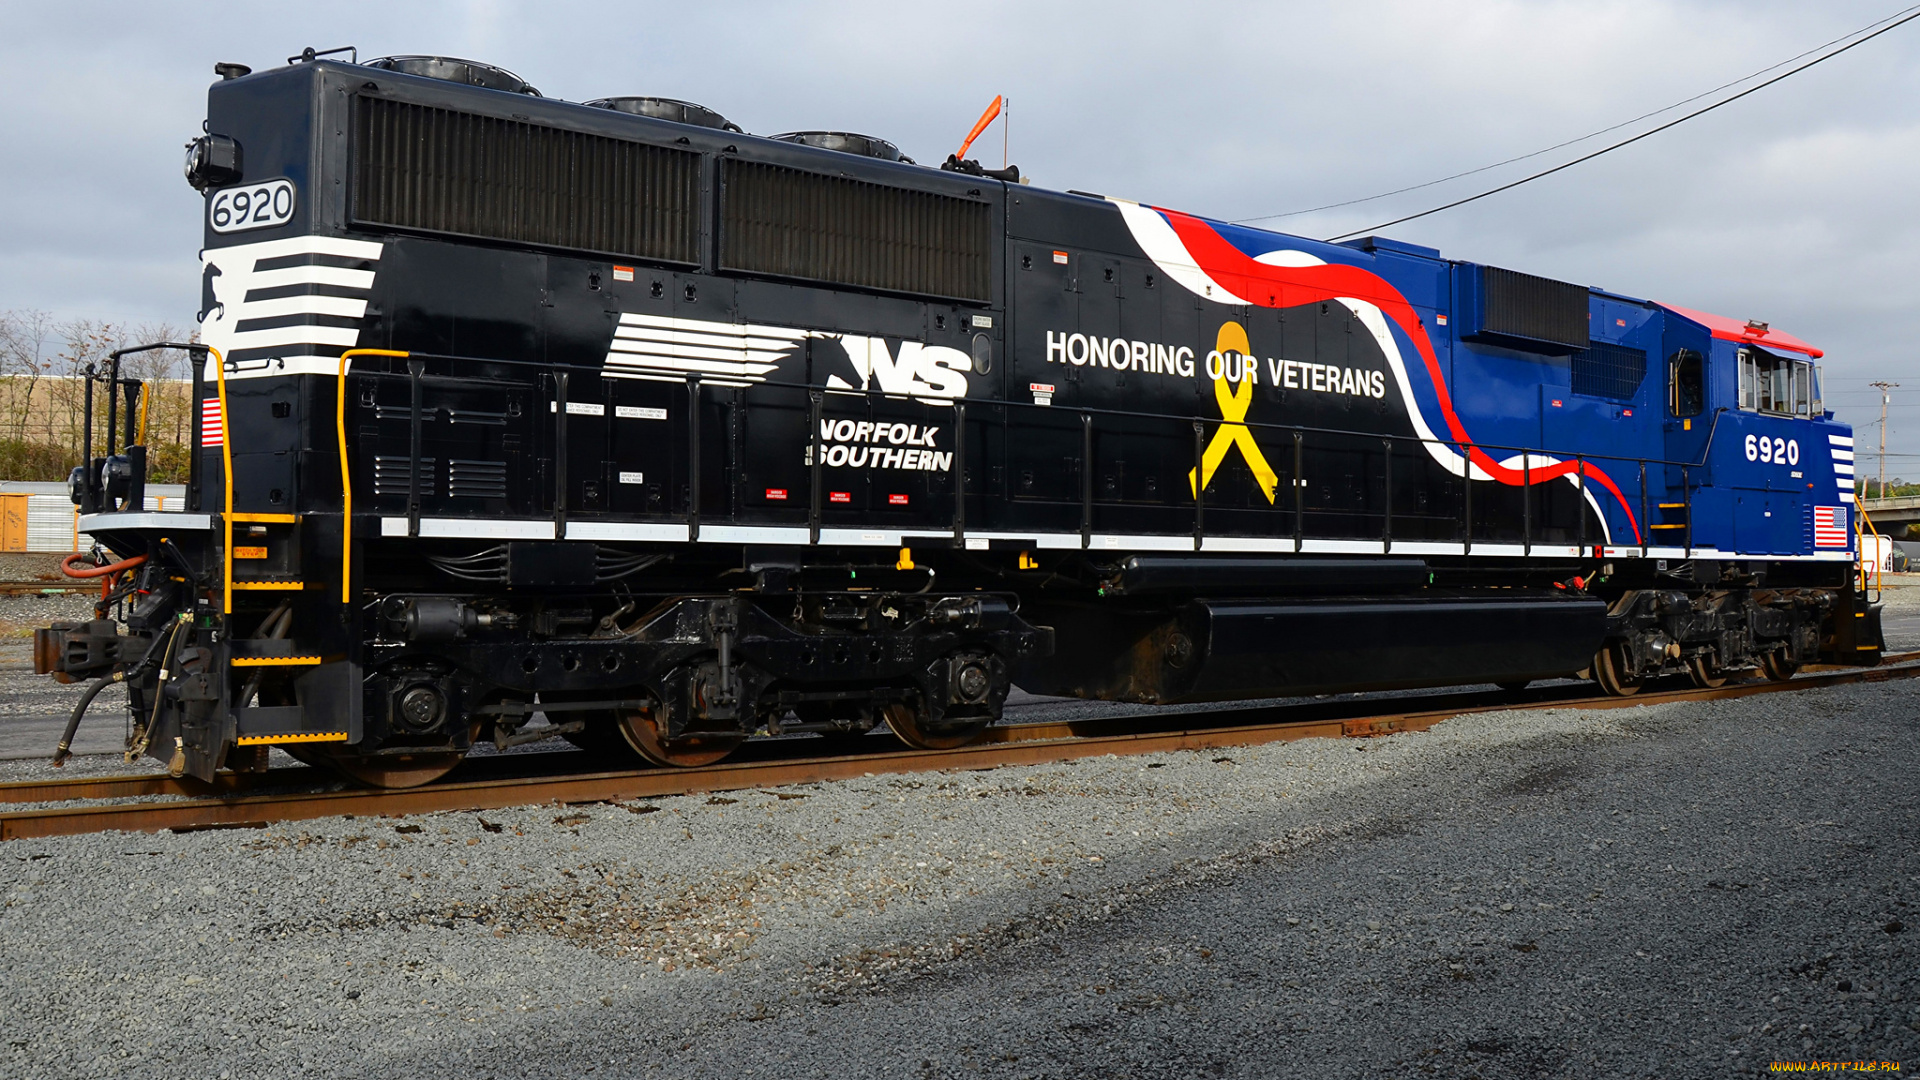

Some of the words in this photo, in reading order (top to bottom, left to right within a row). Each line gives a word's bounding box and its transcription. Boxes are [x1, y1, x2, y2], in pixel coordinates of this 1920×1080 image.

[213, 185, 292, 227] 6920
[1046, 330, 1195, 378] HONORING
[1205, 350, 1258, 385] OUR
[1268, 358, 1385, 399] VETERANS
[811, 419, 939, 447] NORFOLK
[805, 444, 953, 472] SOUTHERN
[1745, 434, 1799, 466] 6920
